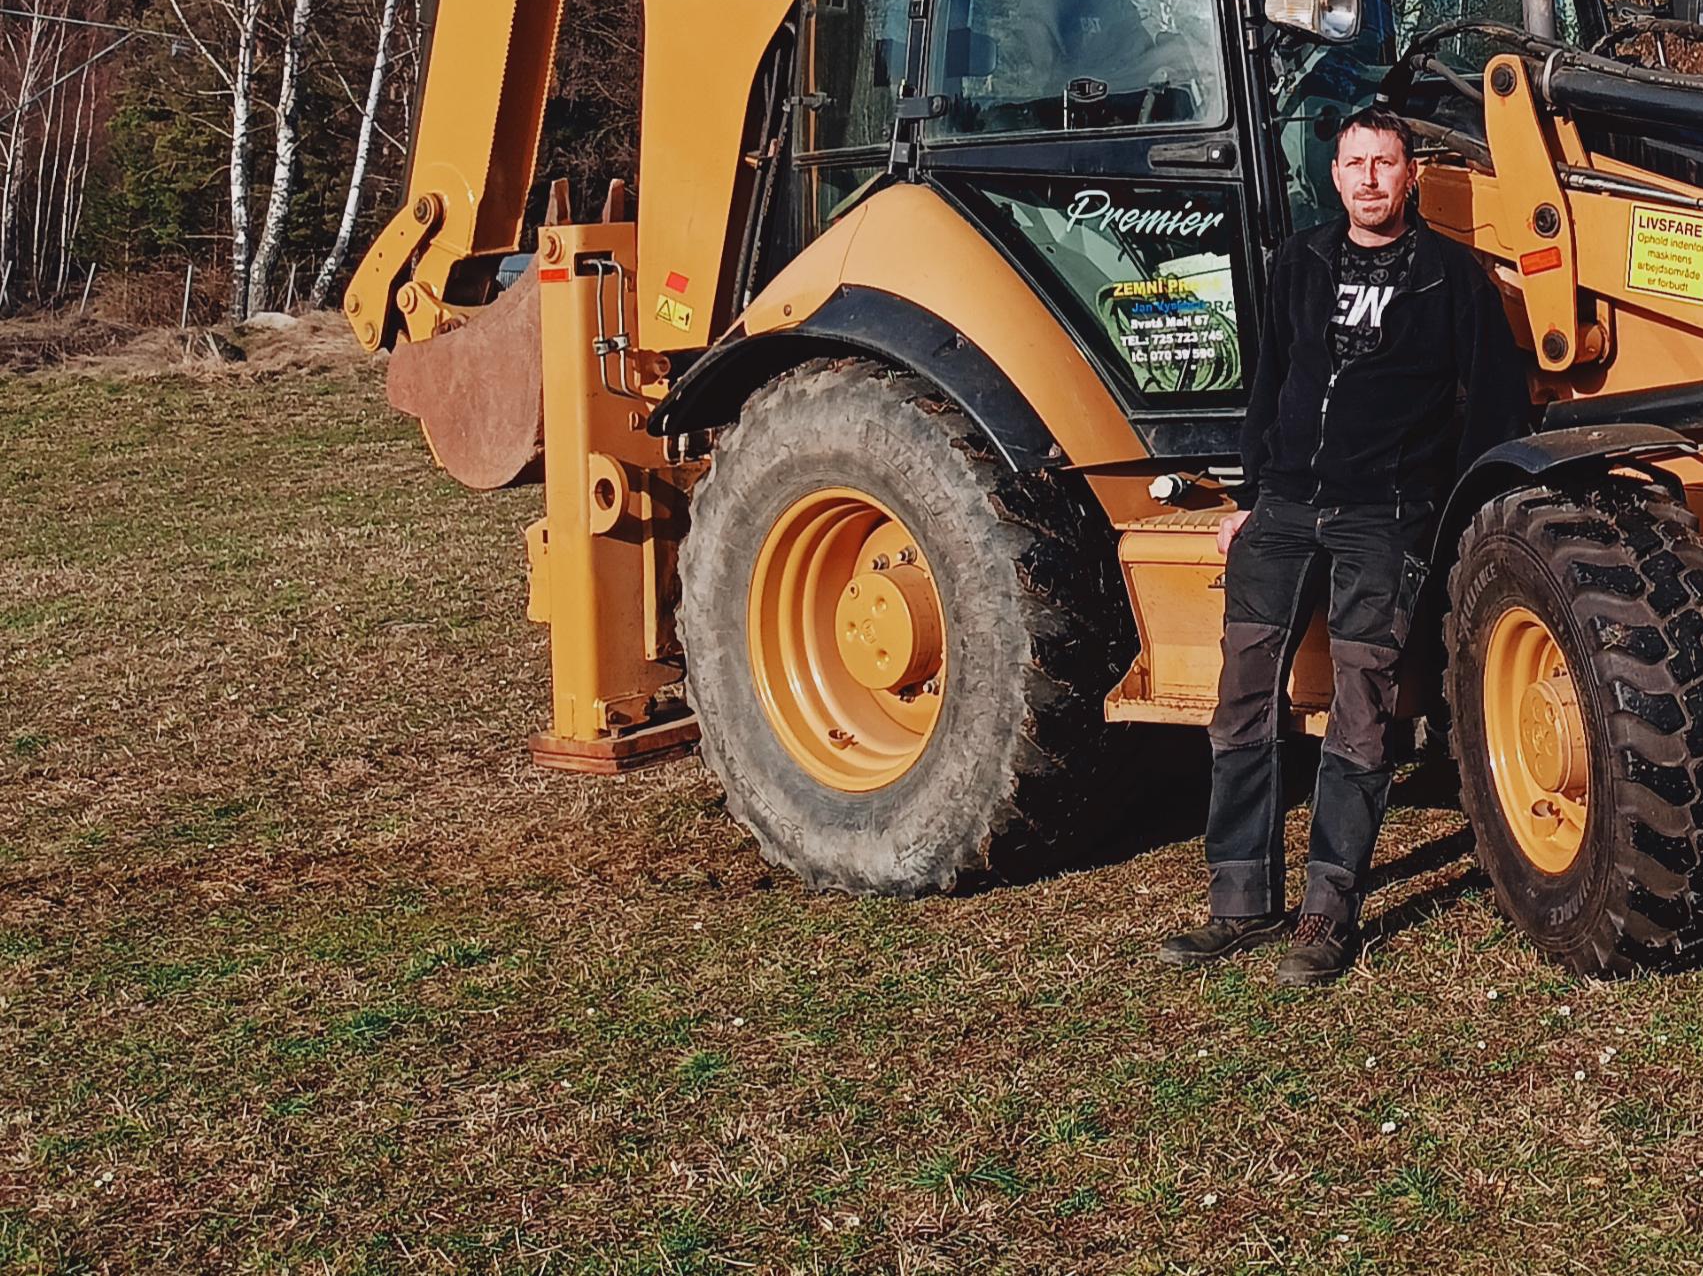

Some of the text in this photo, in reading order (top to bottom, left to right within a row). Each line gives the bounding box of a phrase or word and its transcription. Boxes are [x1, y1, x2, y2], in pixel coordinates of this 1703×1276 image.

[1067, 190, 1224, 237] Premier
[1637, 232, 1668, 246] Ophold
[1647, 248, 1692, 265] maskinens
[1113, 278, 1164, 297] ZEMNÍ
[1151, 333, 1174, 345] 725
[1176, 332, 1198, 343] 723
[1150, 350, 1172, 362] 070
